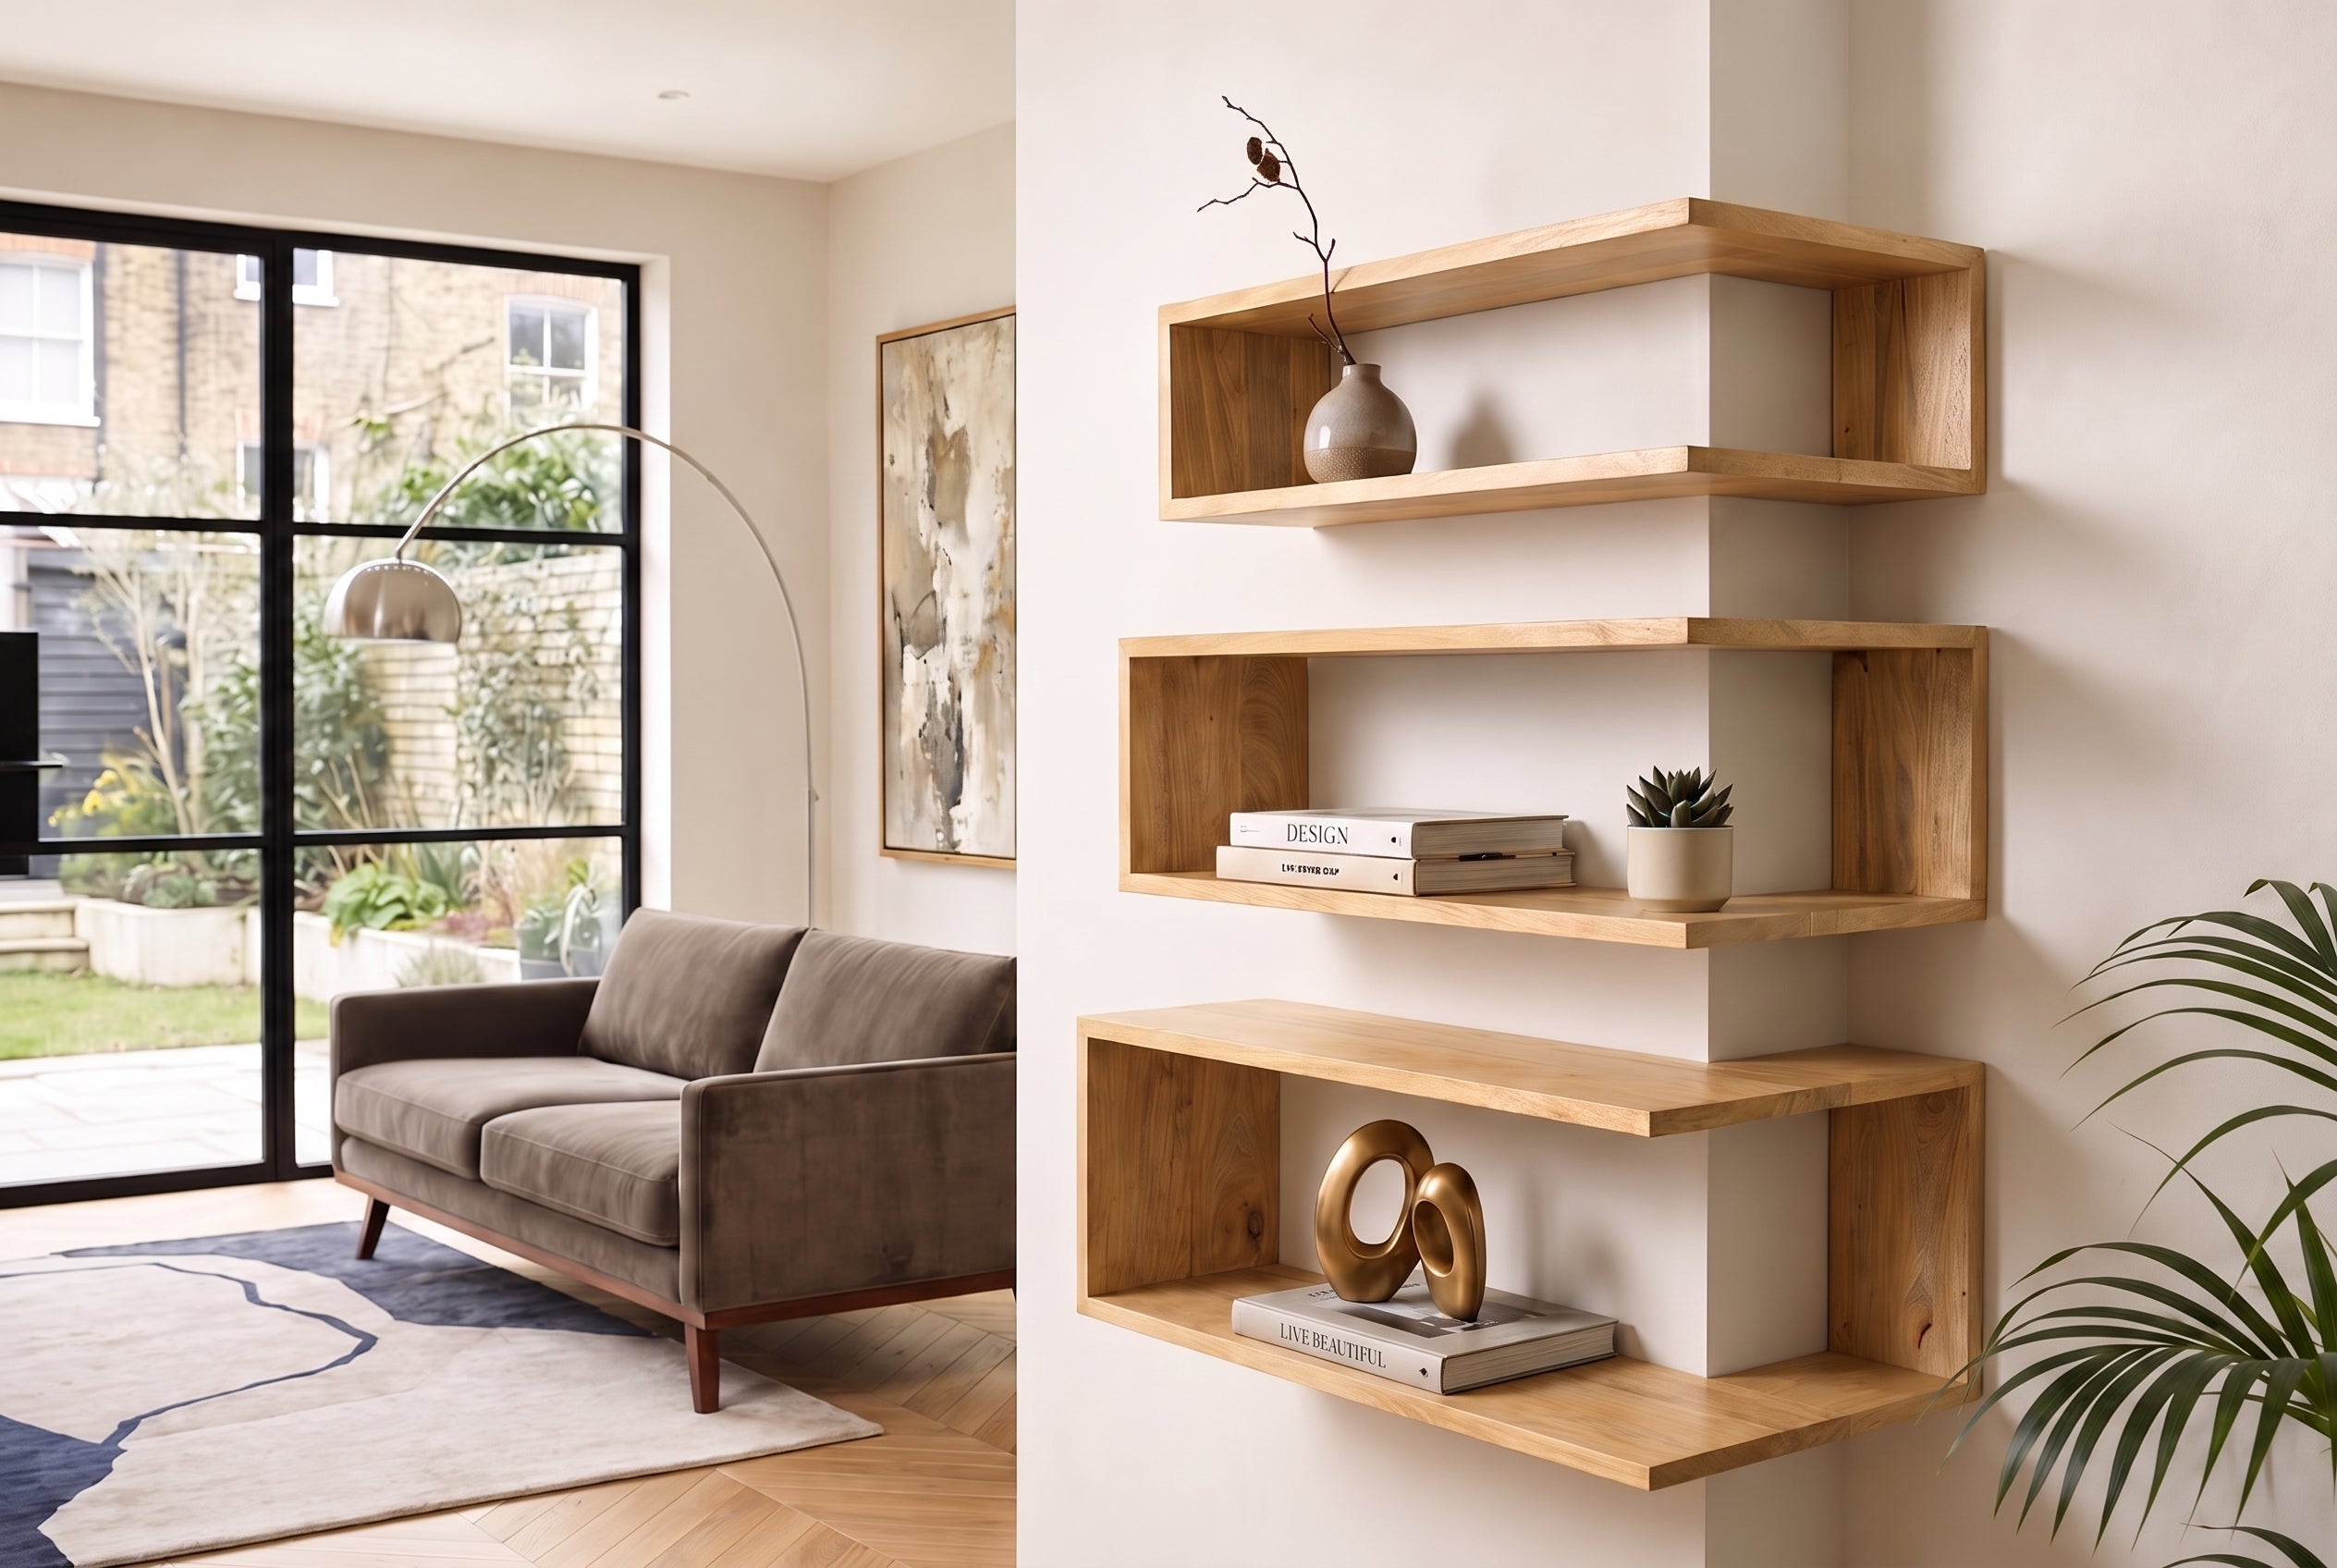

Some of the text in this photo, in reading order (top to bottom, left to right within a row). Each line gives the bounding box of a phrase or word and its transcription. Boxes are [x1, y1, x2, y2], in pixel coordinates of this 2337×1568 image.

[1287, 823, 1349, 845] DESIGN
[1279, 1322, 1387, 1369] LIVE BEAUTIFUL
